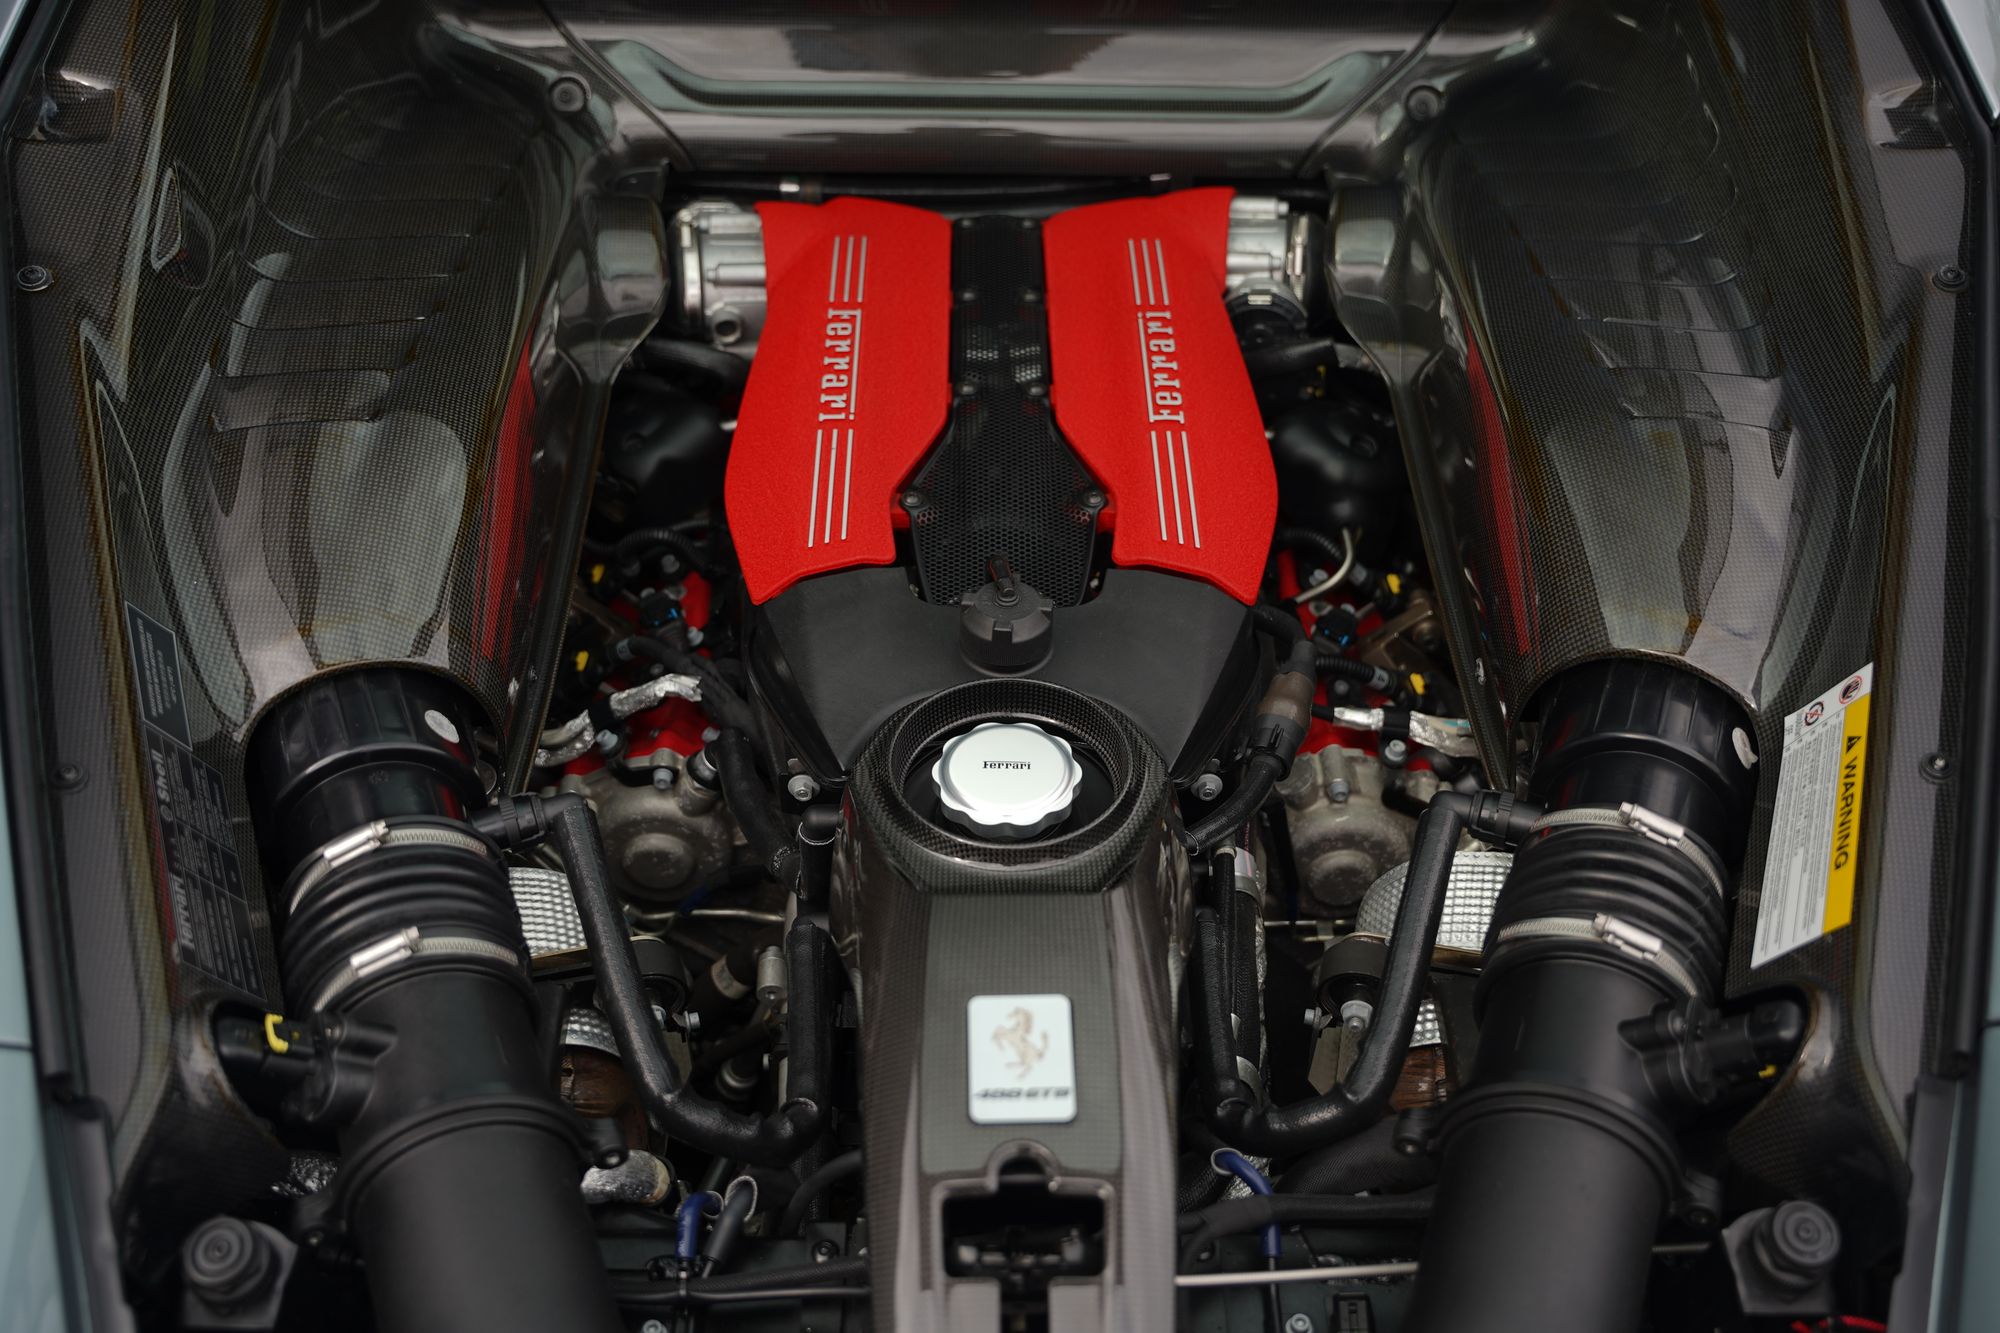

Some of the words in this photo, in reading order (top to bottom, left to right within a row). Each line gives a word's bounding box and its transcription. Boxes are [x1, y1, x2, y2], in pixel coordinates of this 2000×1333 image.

[818, 308, 862, 422] Ferrari
[1137, 310, 1185, 424] Ferrari
[151, 748, 171, 803] Shell
[982, 760, 1032, 770] Ferrari
[1834, 755, 1859, 870] WARNING
